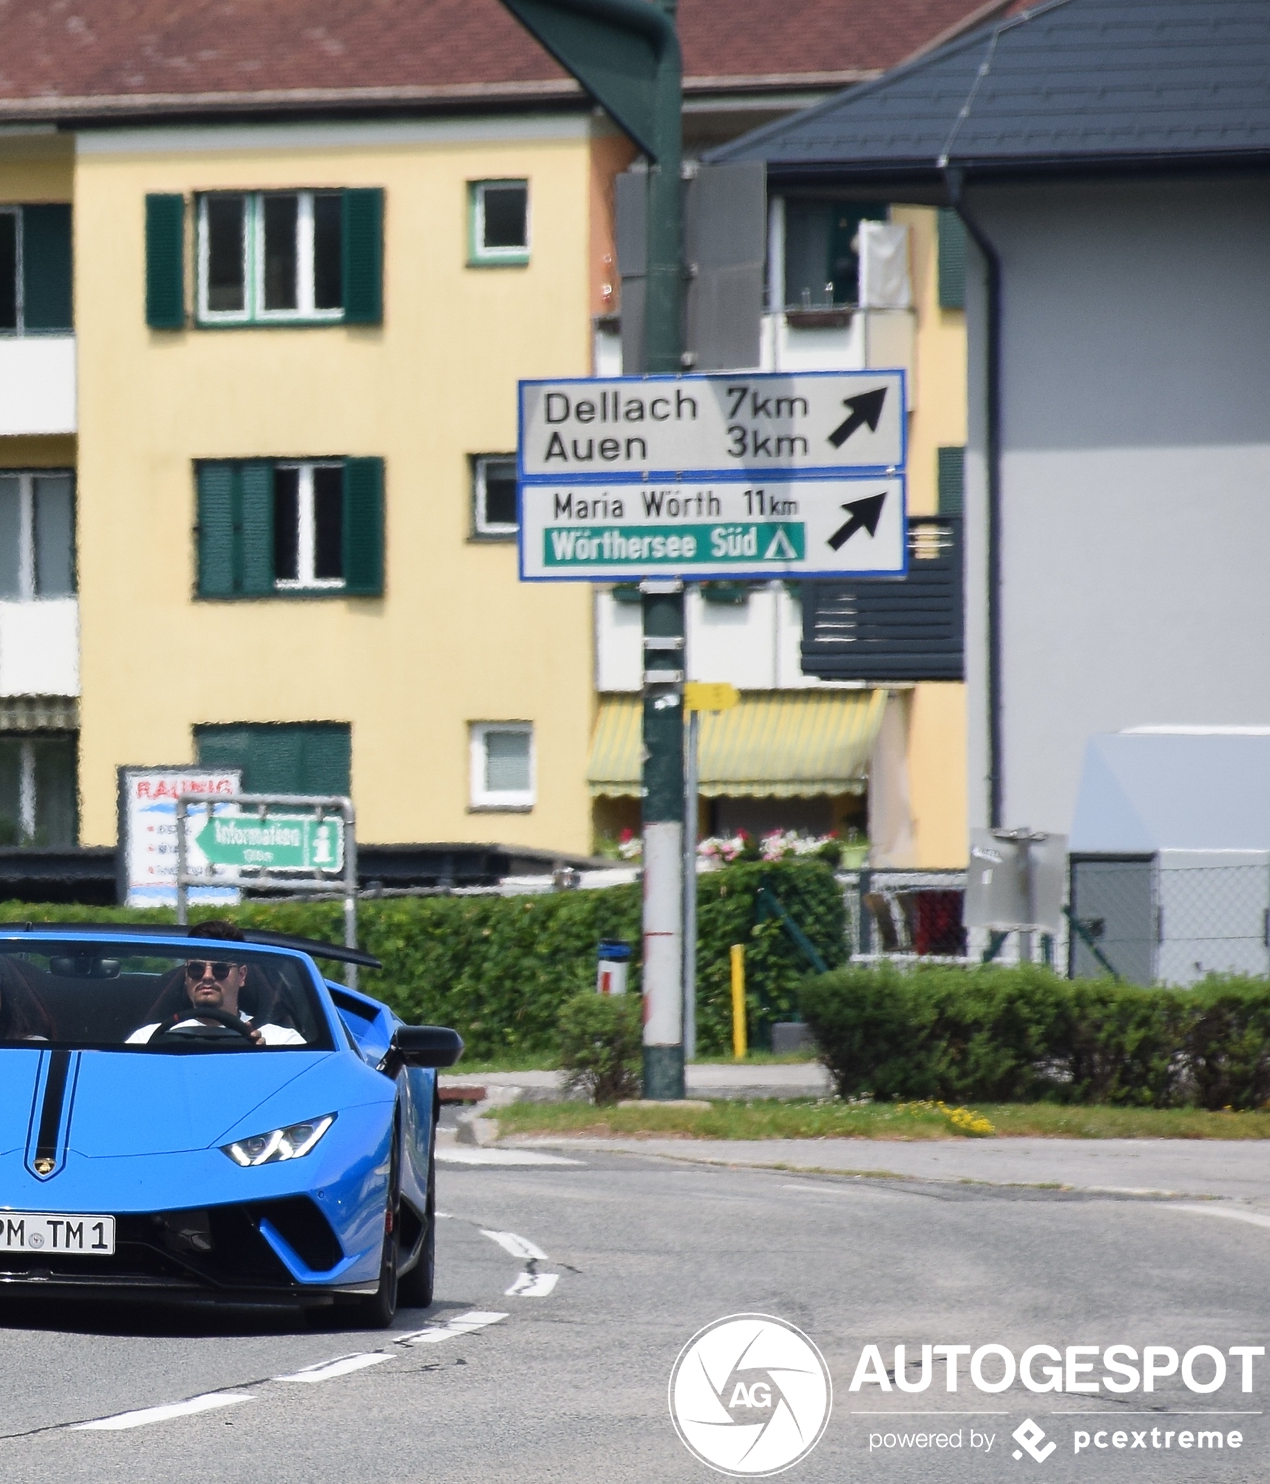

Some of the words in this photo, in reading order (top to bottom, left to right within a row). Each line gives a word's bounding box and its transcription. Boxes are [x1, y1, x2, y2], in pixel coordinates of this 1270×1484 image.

[544, 389, 698, 424] Dellach
[726, 387, 808, 420] 7km
[544, 431, 648, 462] Auen
[726, 425, 808, 458] 3km
[553, 492, 624, 520] Maria
[641, 489, 721, 518] Wörth
[743, 489, 799, 516] 11km
[551, 528, 697, 561] Wörthersee
[710, 526, 758, 557] Süd
[215, 820, 300, 846] Information
[46, 1220, 84, 1249] TM
[91, 1222, 108, 1249] 1
